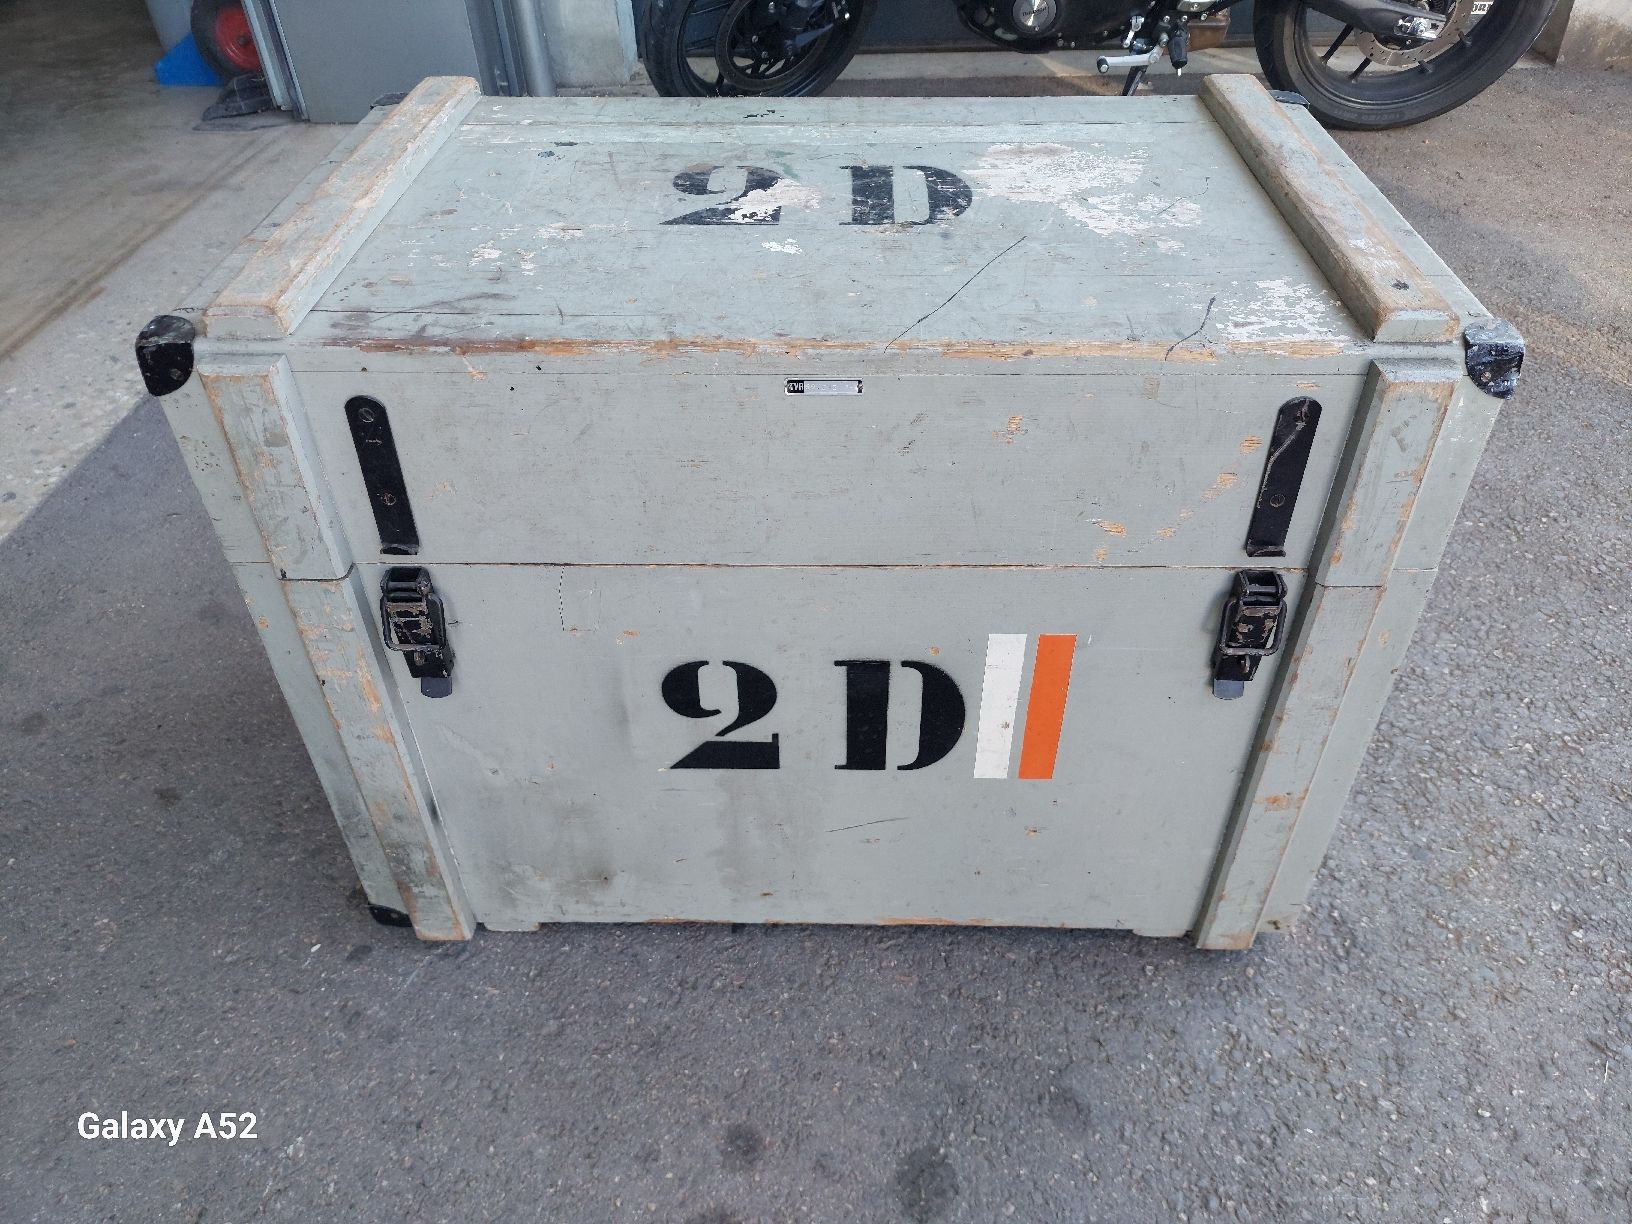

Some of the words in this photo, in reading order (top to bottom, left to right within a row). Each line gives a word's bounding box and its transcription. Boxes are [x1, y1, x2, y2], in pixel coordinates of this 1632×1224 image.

[659, 165, 783, 225] 2
[839, 165, 973, 225] D
[662, 660, 780, 769] 2
[834, 660, 966, 770] D
